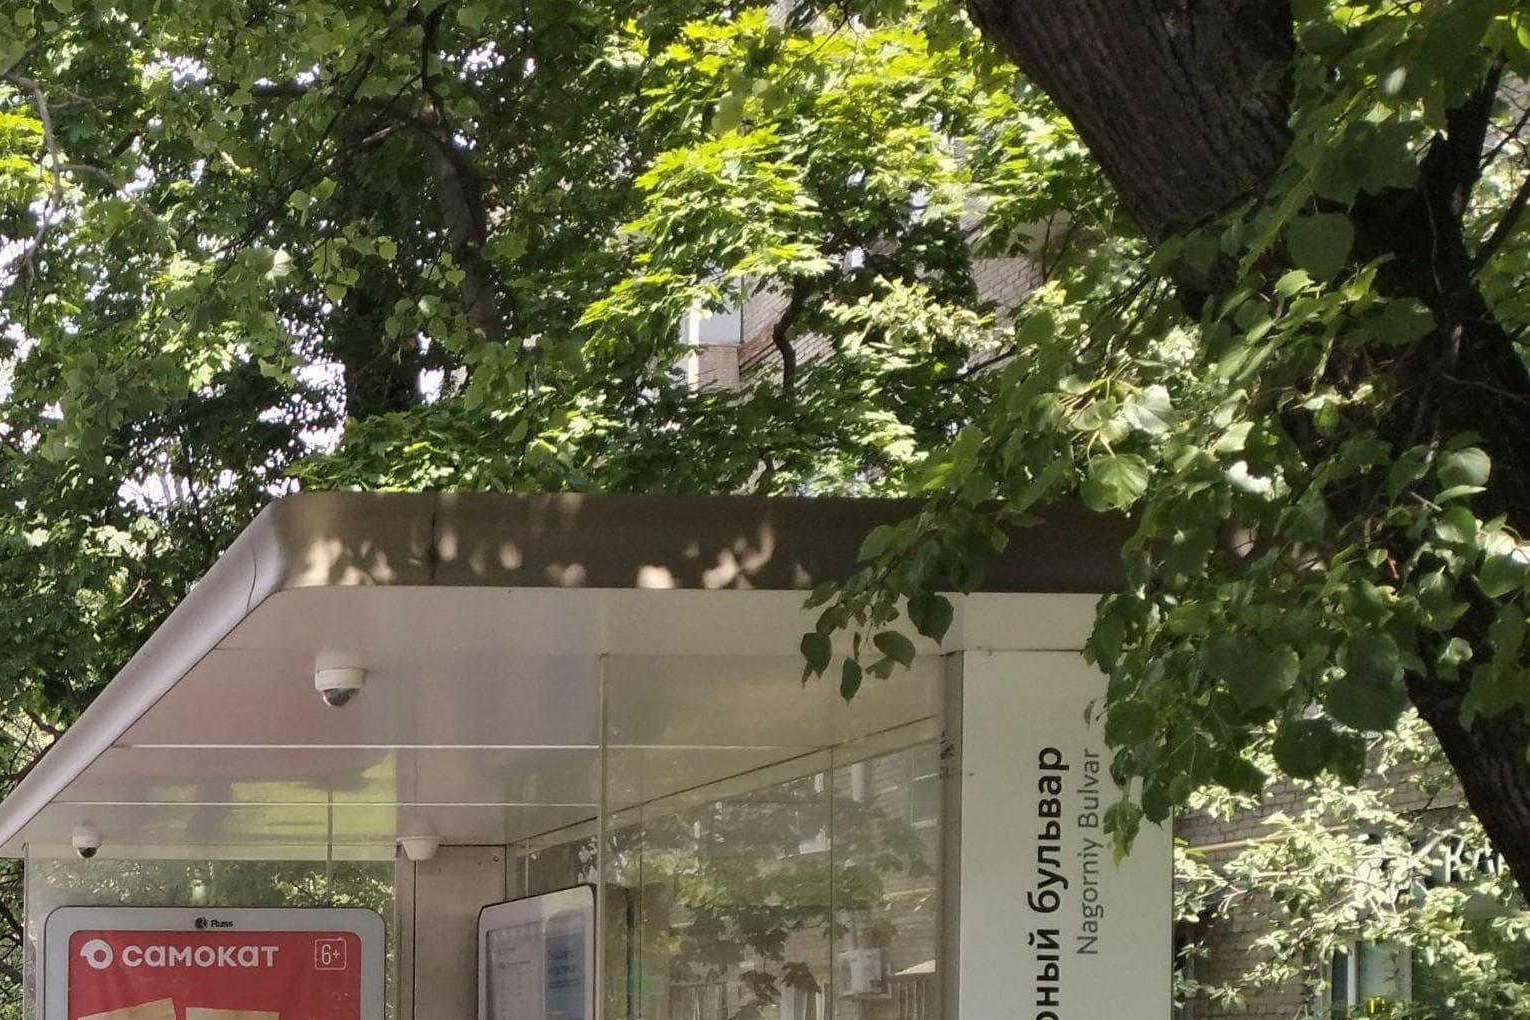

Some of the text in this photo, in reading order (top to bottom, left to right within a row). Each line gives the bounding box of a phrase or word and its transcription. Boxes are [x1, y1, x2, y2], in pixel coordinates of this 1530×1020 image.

[1025, 745, 1070, 915] бульвар
[1077, 747, 1105, 956] Nagorniy Bulvar
[211, 919, 234, 929] Russ
[321, 943, 341, 966] 6+
